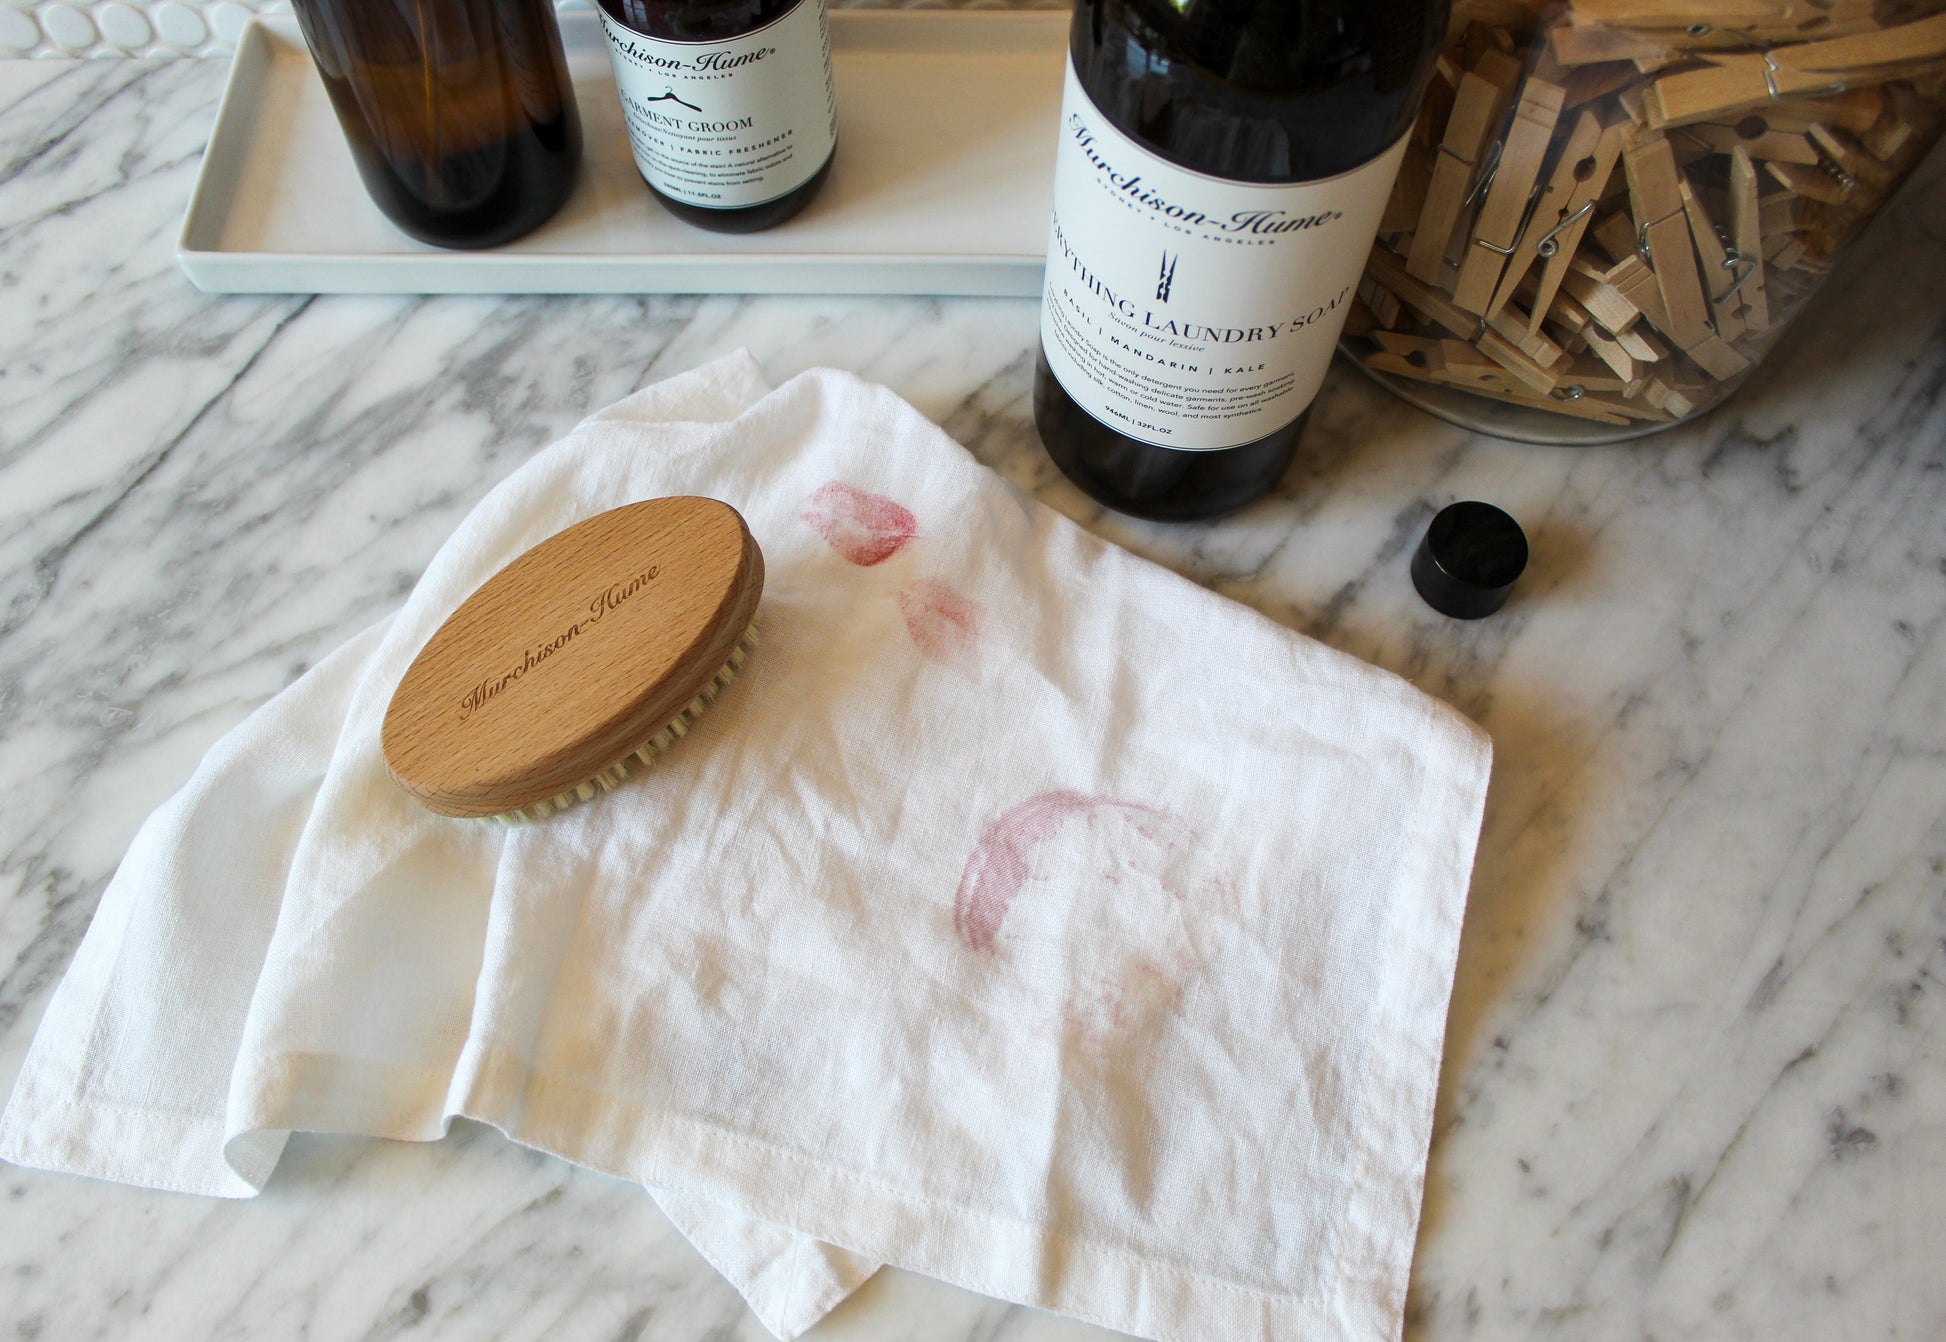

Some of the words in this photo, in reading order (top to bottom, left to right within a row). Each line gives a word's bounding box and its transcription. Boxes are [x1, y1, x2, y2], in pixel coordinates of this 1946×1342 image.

[658, 70, 676, 78] LOS
[680, 147, 721, 156] FABRIC
[729, 130, 792, 154] FRESHENER
[688, 117, 753, 132] GROOM
[1069, 113, 1333, 234] Murchison-Hume
[1164, 222, 1192, 234] LOS
[1203, 234, 1276, 246] ANGELES
[1064, 288, 1092, 325] BASIL
[1111, 336, 1198, 372] MANDARIN
[1224, 364, 1265, 374] KALE
[1108, 311, 1138, 333] Savon
[1139, 331, 1167, 344] pour
[1169, 339, 1206, 352] lessive
[1145, 310, 1285, 343] LAUNDRY
[1289, 286, 1350, 333] SOAP
[1086, 339, 1102, 357] Soap
[1110, 358, 1122, 368] the
[1123, 366, 1140, 378] only
[1141, 374, 1182, 391] detergent
[1240, 384, 1262, 392] every
[1089, 352, 1098, 362] for
[1098, 360, 1150, 392] hand-washing
[1151, 388, 1184, 400] delicate
[1230, 390, 1266, 403] pre-wash
[1108, 378, 1128, 392] warm
[1140, 392, 1158, 402] cold
[1105, 405, 1130, 423] 946ML
[1137, 418, 1172, 434] 32FL.OZ
[460, 563, 661, 720] Murchison-Hume
